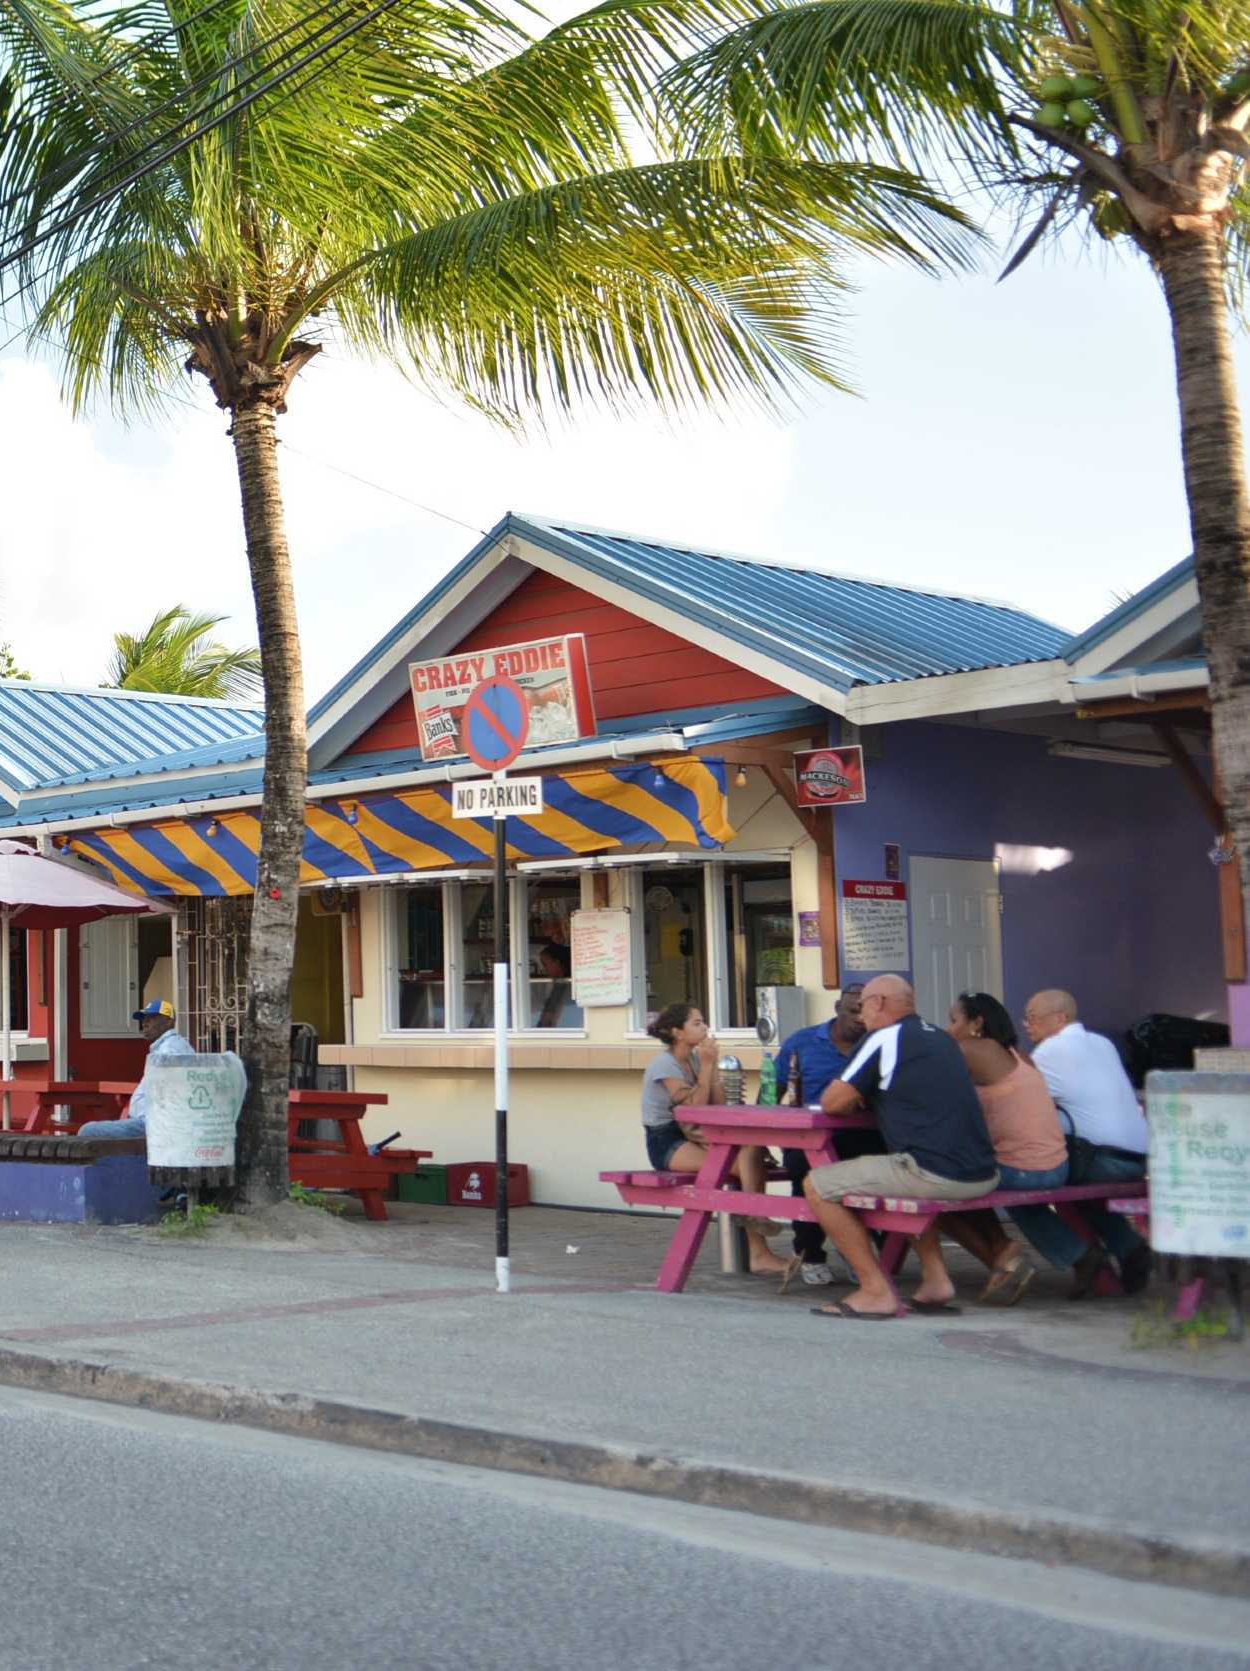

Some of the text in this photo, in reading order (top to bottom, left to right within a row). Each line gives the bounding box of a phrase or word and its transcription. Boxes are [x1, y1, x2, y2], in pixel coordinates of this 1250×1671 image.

[412, 643, 566, 693] CRAZY EDDIE
[424, 718, 454, 740] Banks
[456, 784, 538, 810] NO PARKING
